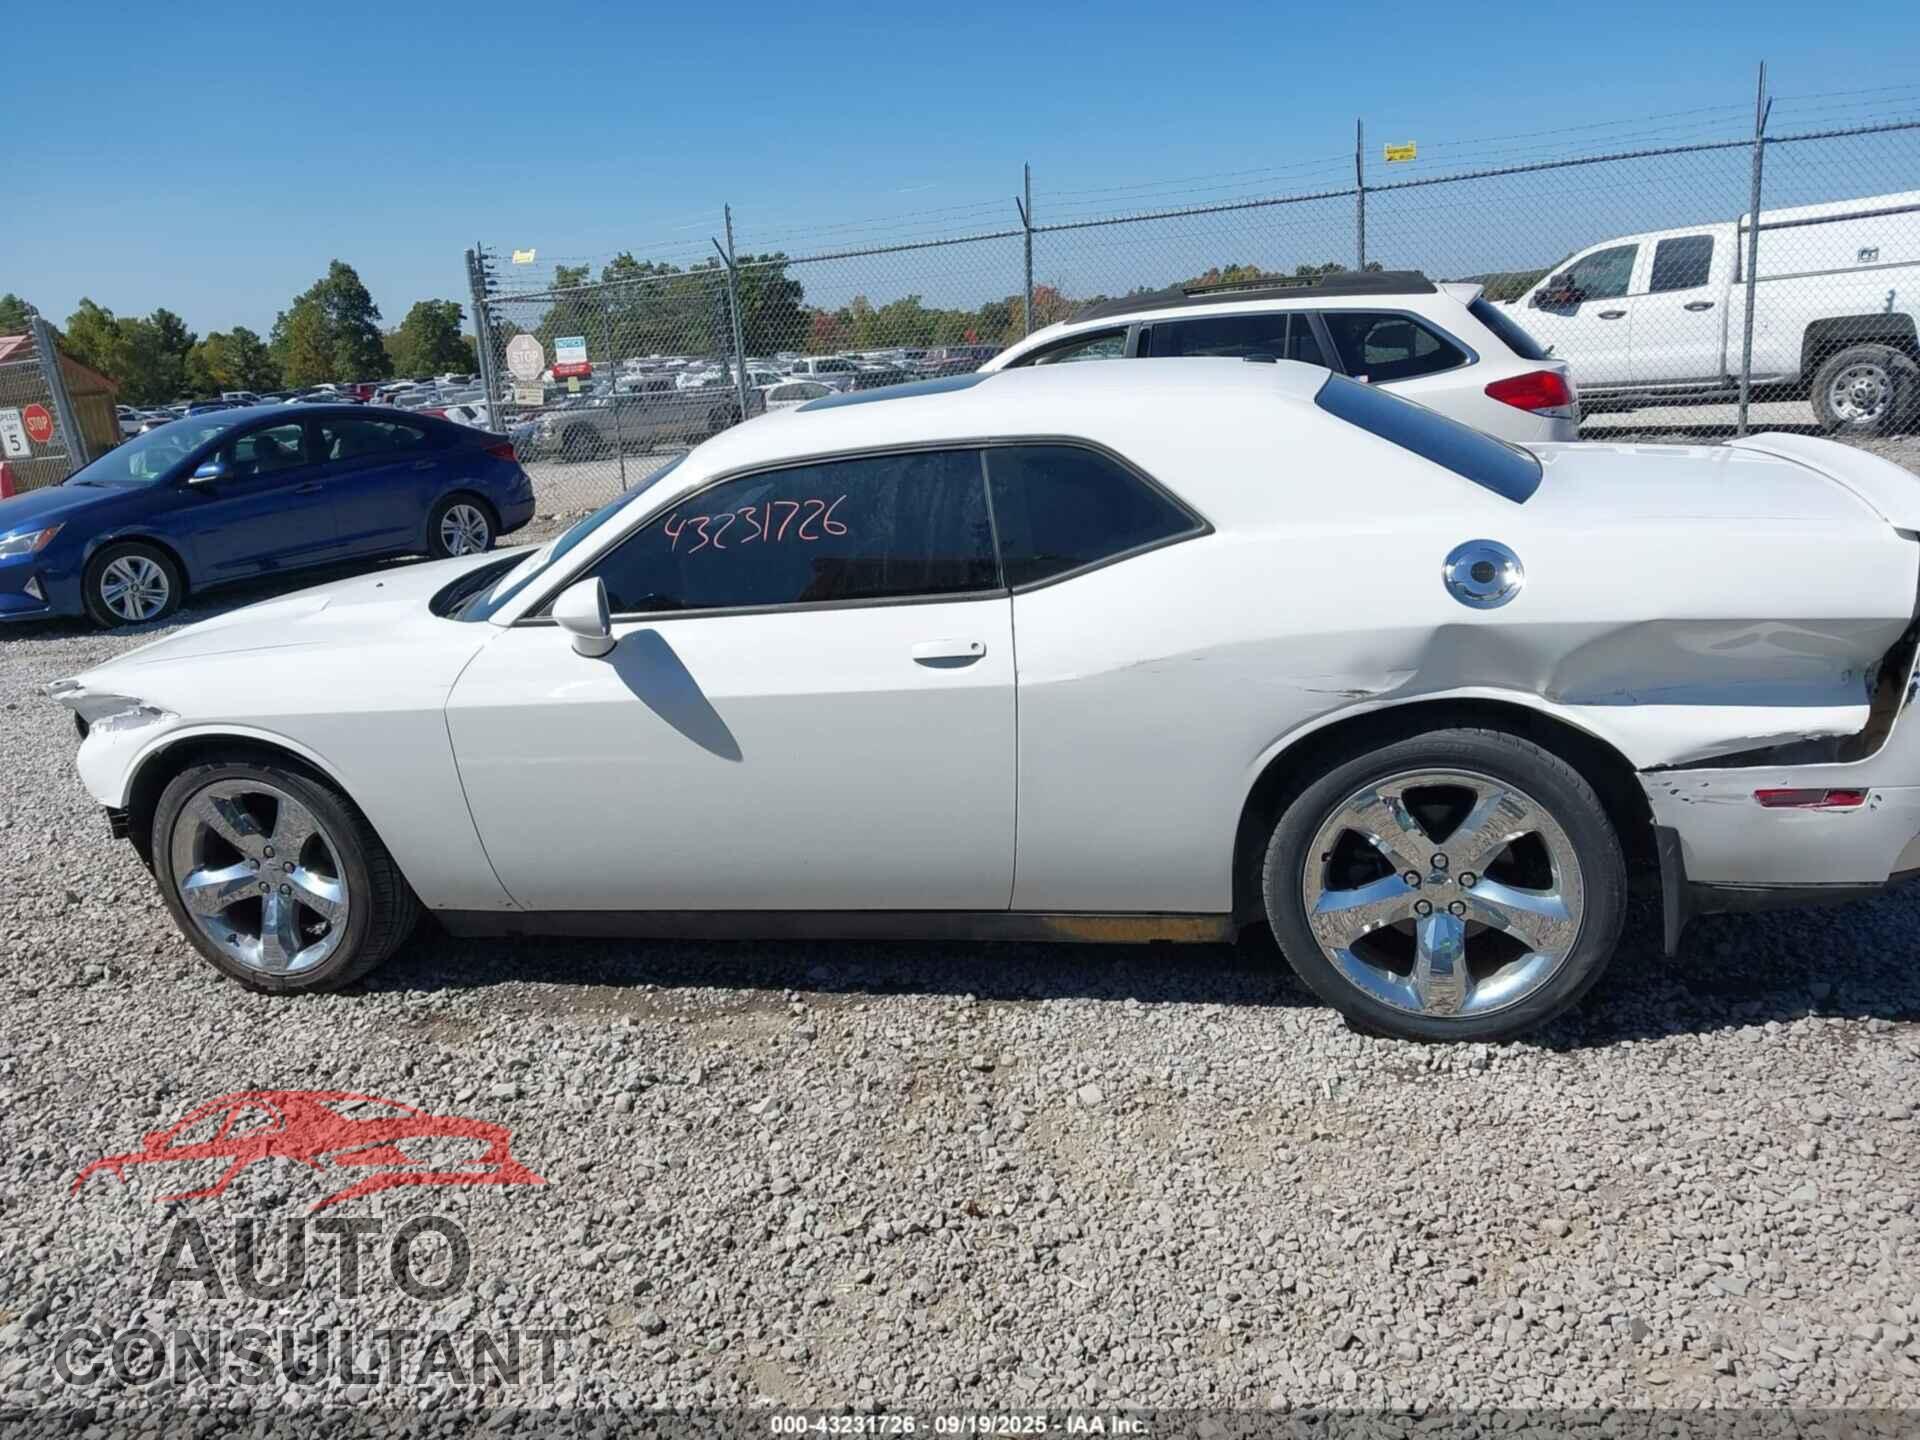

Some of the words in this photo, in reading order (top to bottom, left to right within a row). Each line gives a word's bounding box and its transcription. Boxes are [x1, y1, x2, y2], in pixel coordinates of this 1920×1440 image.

[511, 351, 537, 362] STOP
[27, 416, 48, 431] STOP
[9, 434, 21, 451] 5
[664, 494, 848, 554] 43231726
